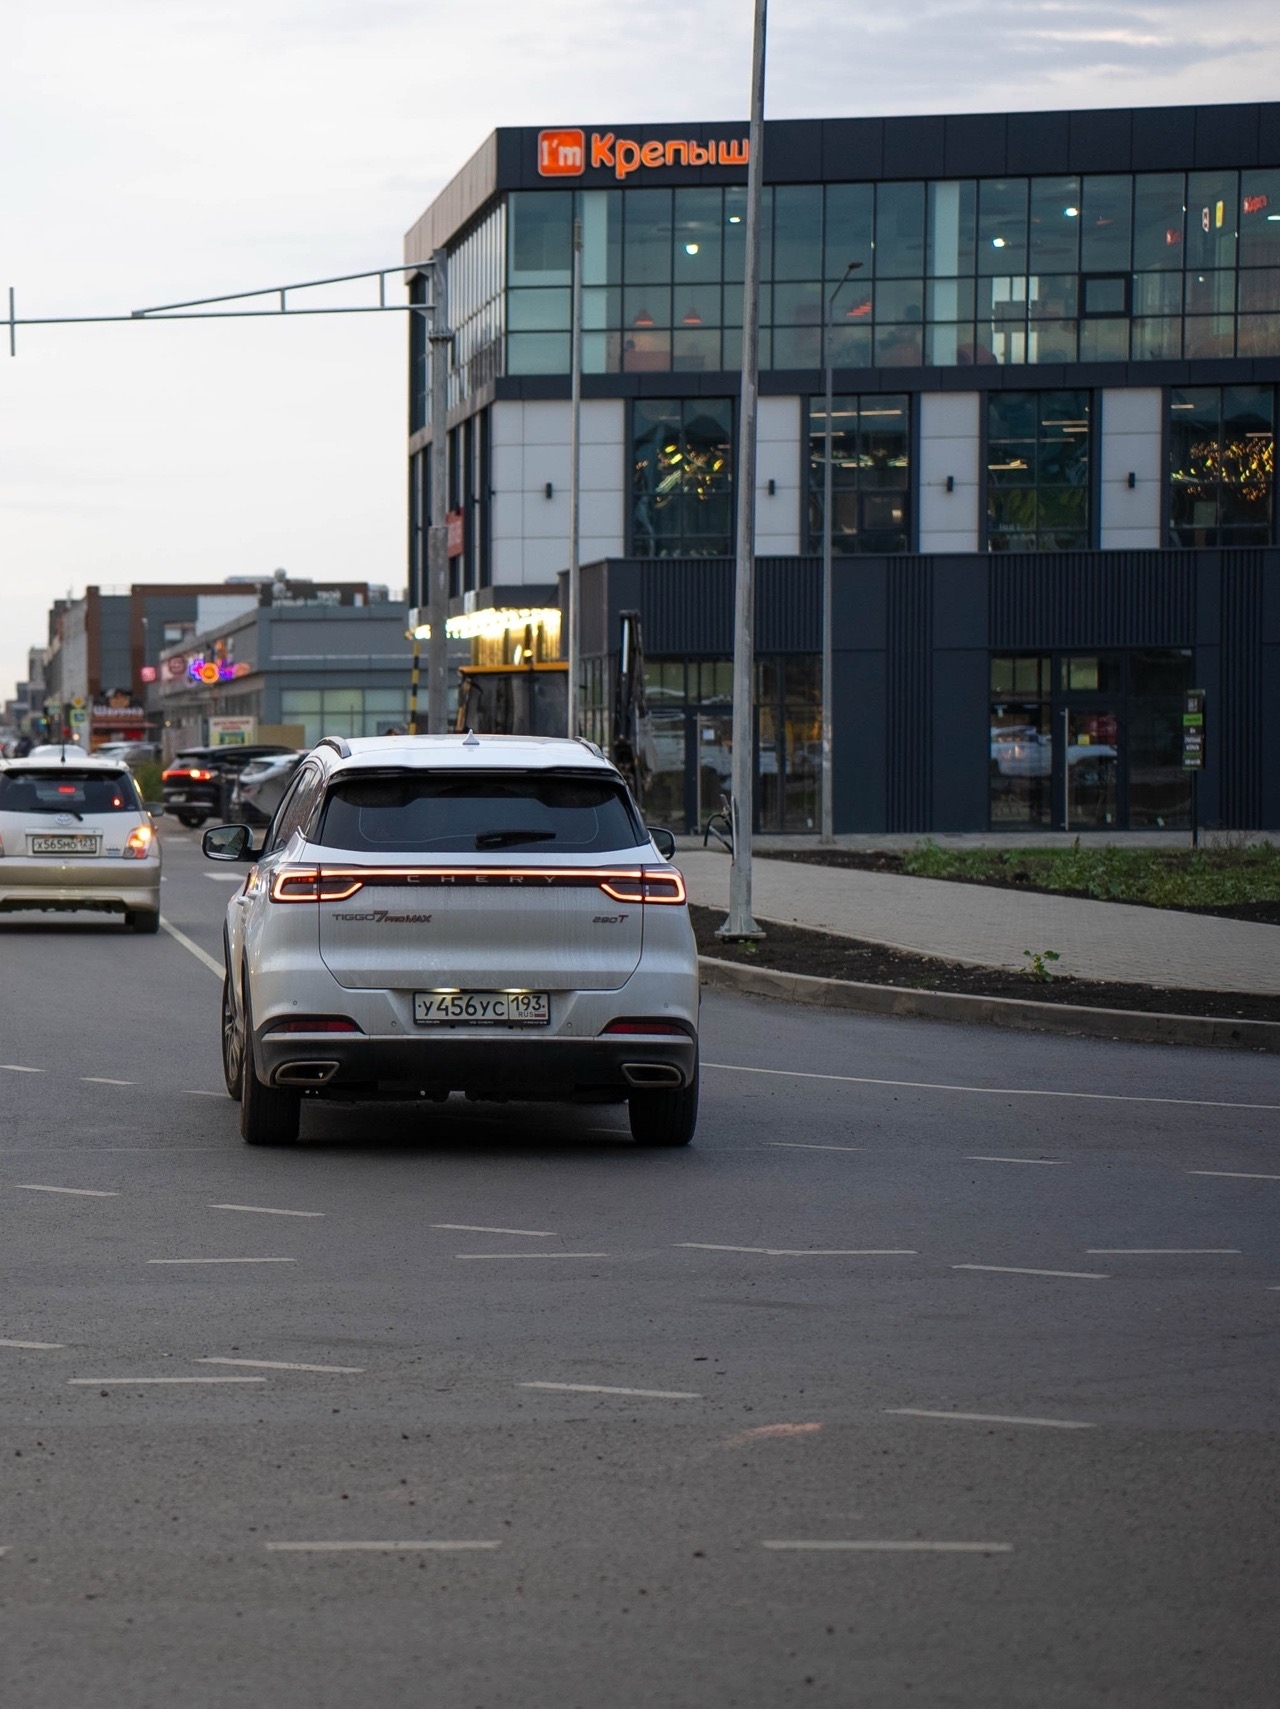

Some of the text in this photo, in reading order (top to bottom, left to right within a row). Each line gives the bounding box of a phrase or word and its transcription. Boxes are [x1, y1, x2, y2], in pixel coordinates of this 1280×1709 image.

[591, 132, 750, 180] Крепыш
[407, 875, 556, 883] CHERY
[422, 995, 543, 1017] У456УС 193
